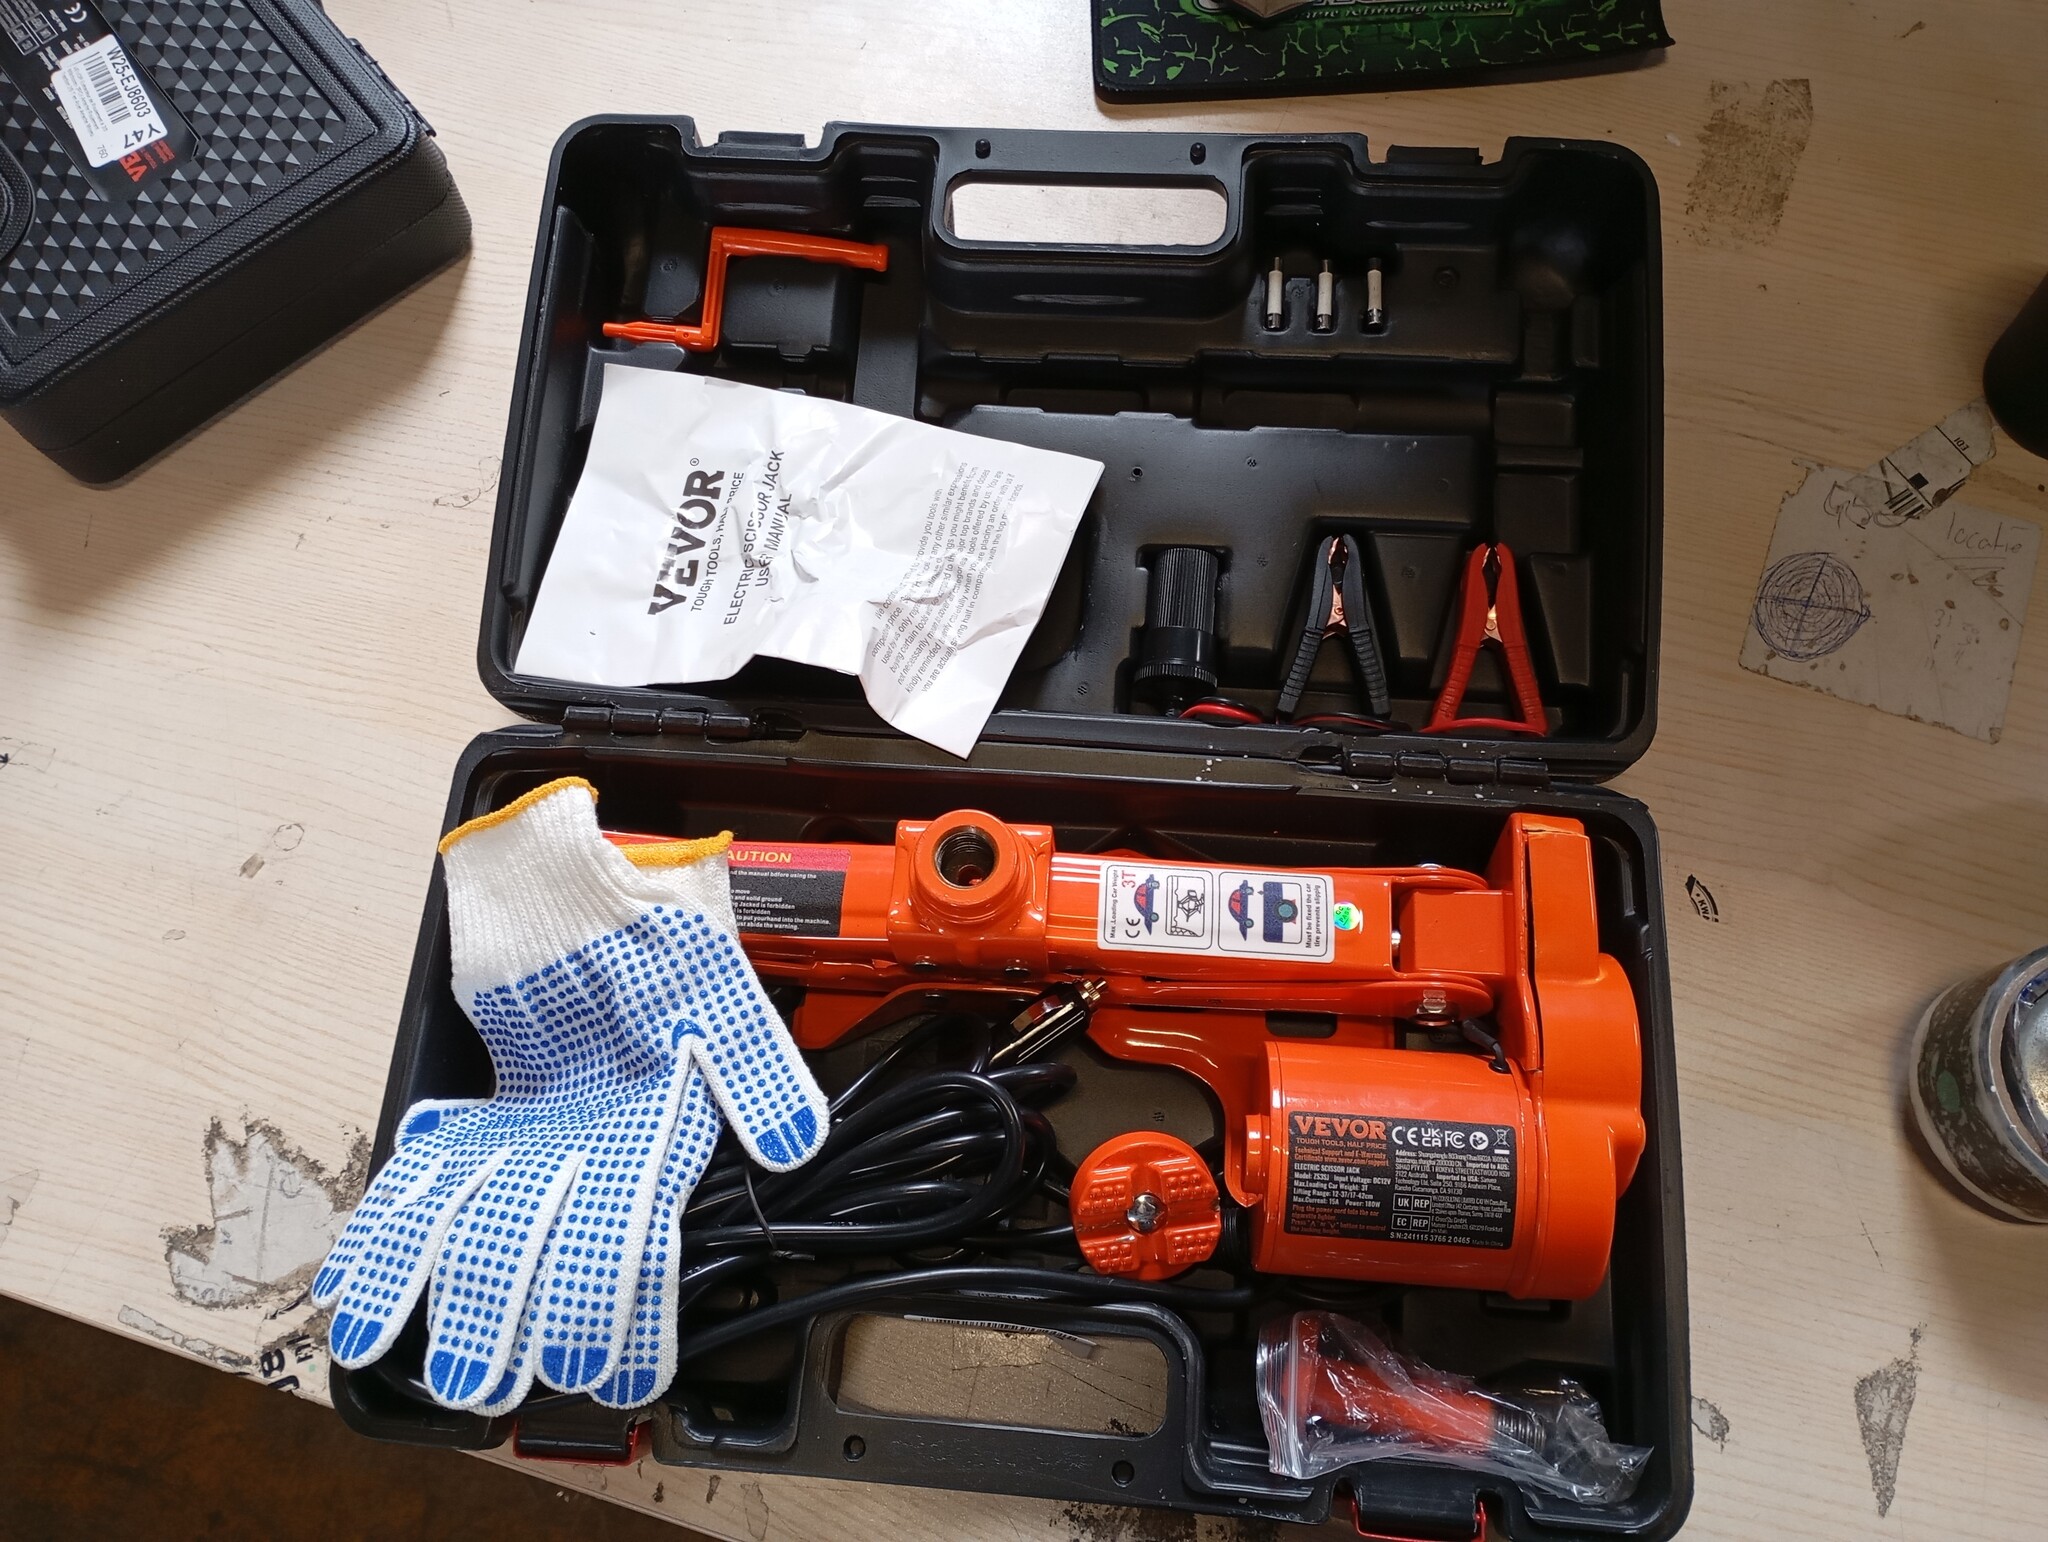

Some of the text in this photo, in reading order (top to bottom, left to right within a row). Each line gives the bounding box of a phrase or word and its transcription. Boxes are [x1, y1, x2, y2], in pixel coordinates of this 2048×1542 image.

[123, 123, 161, 149] Y47
[971, 483, 981, 498] and
[922, 486, 942, 536] you tools with
[939, 496, 952, 521] similar
[951, 500, 965, 522] might
[962, 497, 977, 523] brands
[979, 498, 989, 509] by
[932, 521, 945, 541] other
[948, 523, 960, 538] you
[959, 523, 970, 537] top
[970, 509, 985, 535] offered
[995, 519, 1007, 533] top
[647, 470, 725, 615] VEVOR
[724, 557, 754, 625] ELECTRIC
[762, 450, 785, 491] JACK
[966, 535, 978, 555] tools
[991, 532, 1001, 545] the
[929, 540, 941, 555] any
[691, 578, 714, 612] TOUGH
[706, 533, 724, 577] TOOLS,
[945, 562, 953, 572] to
[903, 673, 922, 693] kindly
[916, 641, 942, 674] reminded
[961, 571, 974, 594] when
[979, 522, 995, 550] placing
[988, 513, 996, 523] an
[967, 599, 975, 609] in
[886, 603, 903, 626] price.
[896, 615, 913, 632] only
[915, 613, 928, 631] tools
[960, 607, 972, 624] half
[899, 628, 918, 653] certain
[880, 646, 893, 664] used
[901, 636, 931, 674] necessarily
[929, 668, 940, 680] are
[727, 849, 792, 862] AUTION
[1121, 869, 1136, 888] 3T
[1125, 917, 1140, 937] CE
[1293, 1115, 1387, 1140] VEVOR
[1321, 1139, 1345, 1147] TOOLS,
[1294, 1163, 1319, 1171] ELECTRIC
[1321, 1164, 1345, 1172] SCISSOR
[1333, 1174, 1348, 1182] Input
[1312, 1189, 1331, 1197] Range:
[1397, 1197, 1409, 1207] UK
[1414, 1198, 1430, 1208] REP
[1396, 1217, 1407, 1226] EC
[1412, 1218, 1428, 1227] REP
